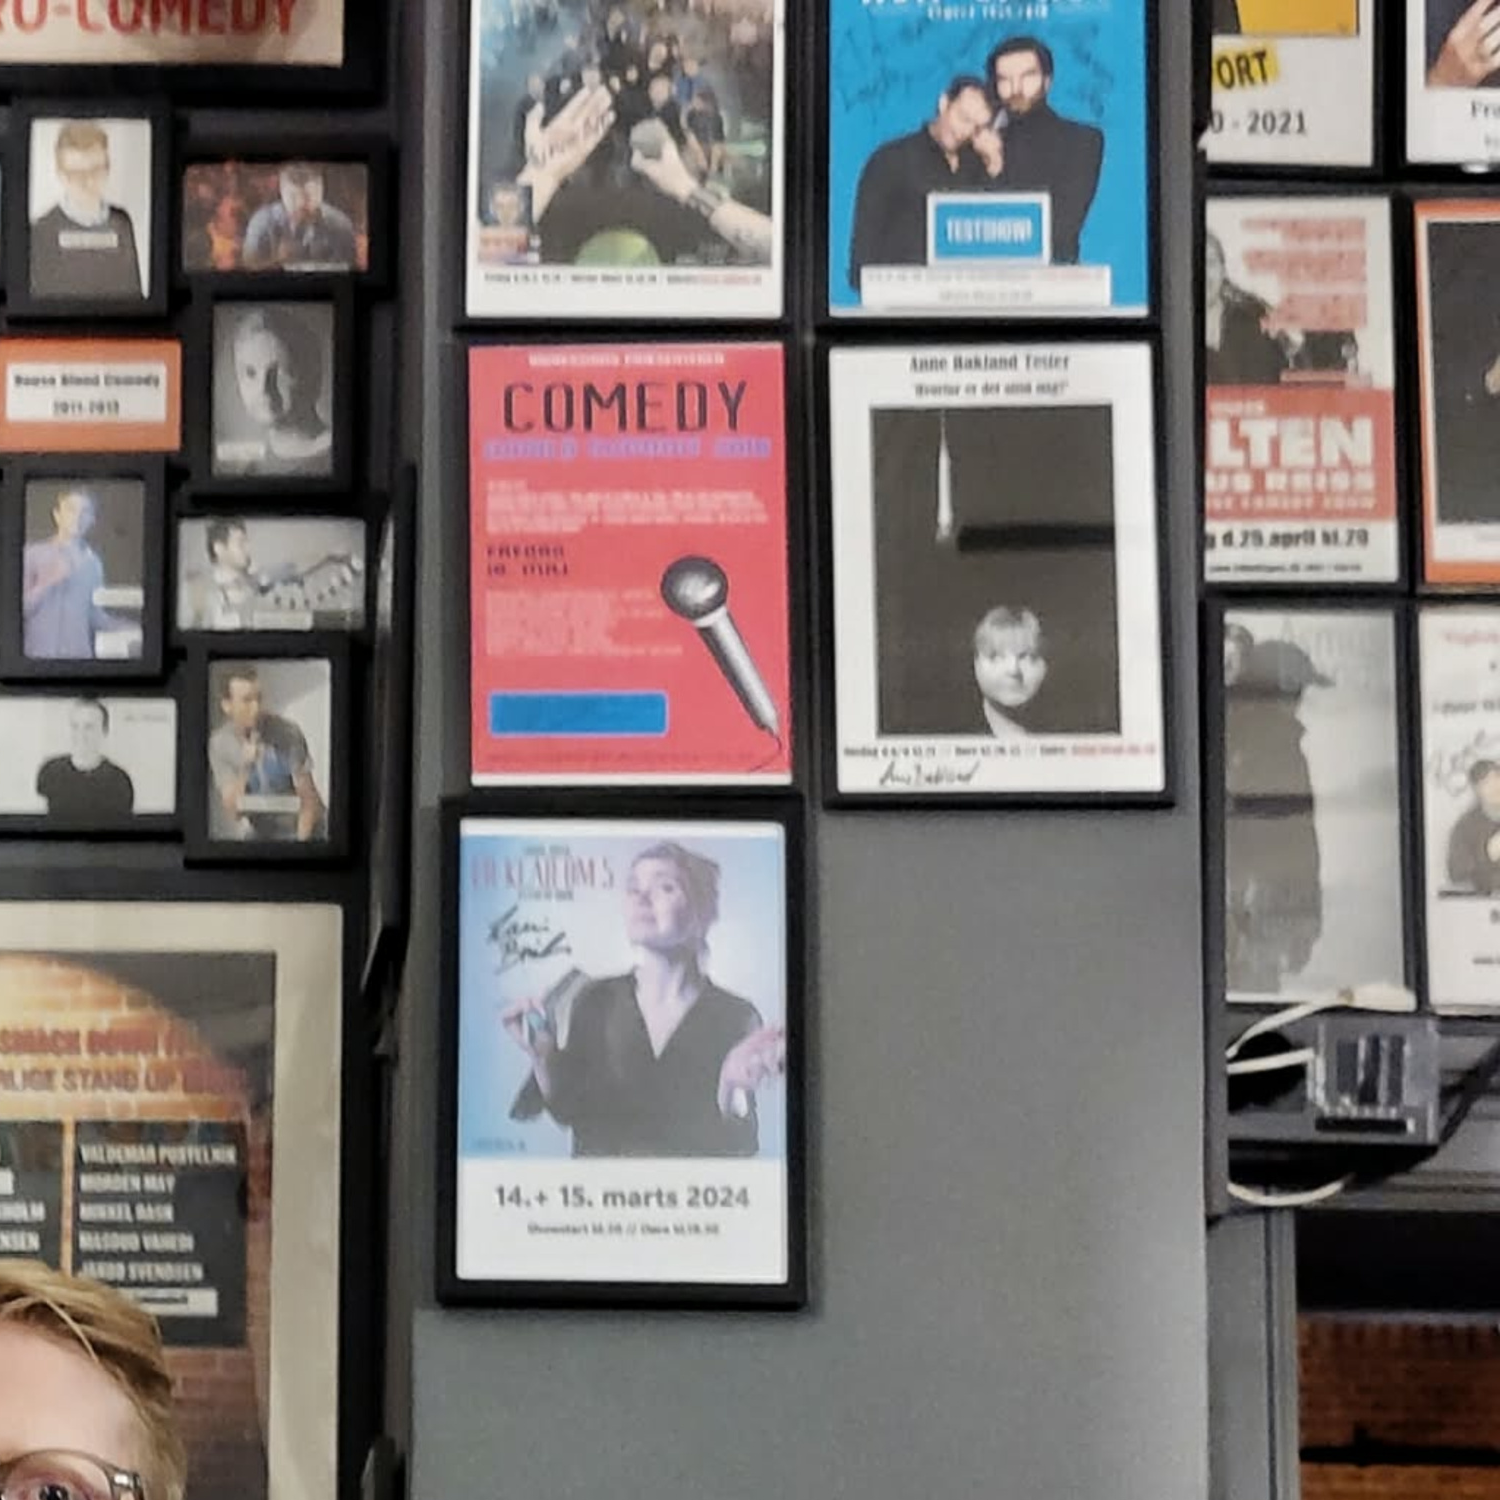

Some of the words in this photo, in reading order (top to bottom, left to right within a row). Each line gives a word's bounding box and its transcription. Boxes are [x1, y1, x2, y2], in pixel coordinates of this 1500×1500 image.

[1215, 50, 1267, 90] ORT
[1247, 111, 1306, 134] 2021
[909, 355, 948, 372] Anne
[503, 379, 748, 434] COMEDY
[1210, 417, 1373, 467] LTEN
[559, 1185, 594, 1209] 15.
[601, 1186, 679, 1210] marts
[686, 1185, 751, 1209] 2024
